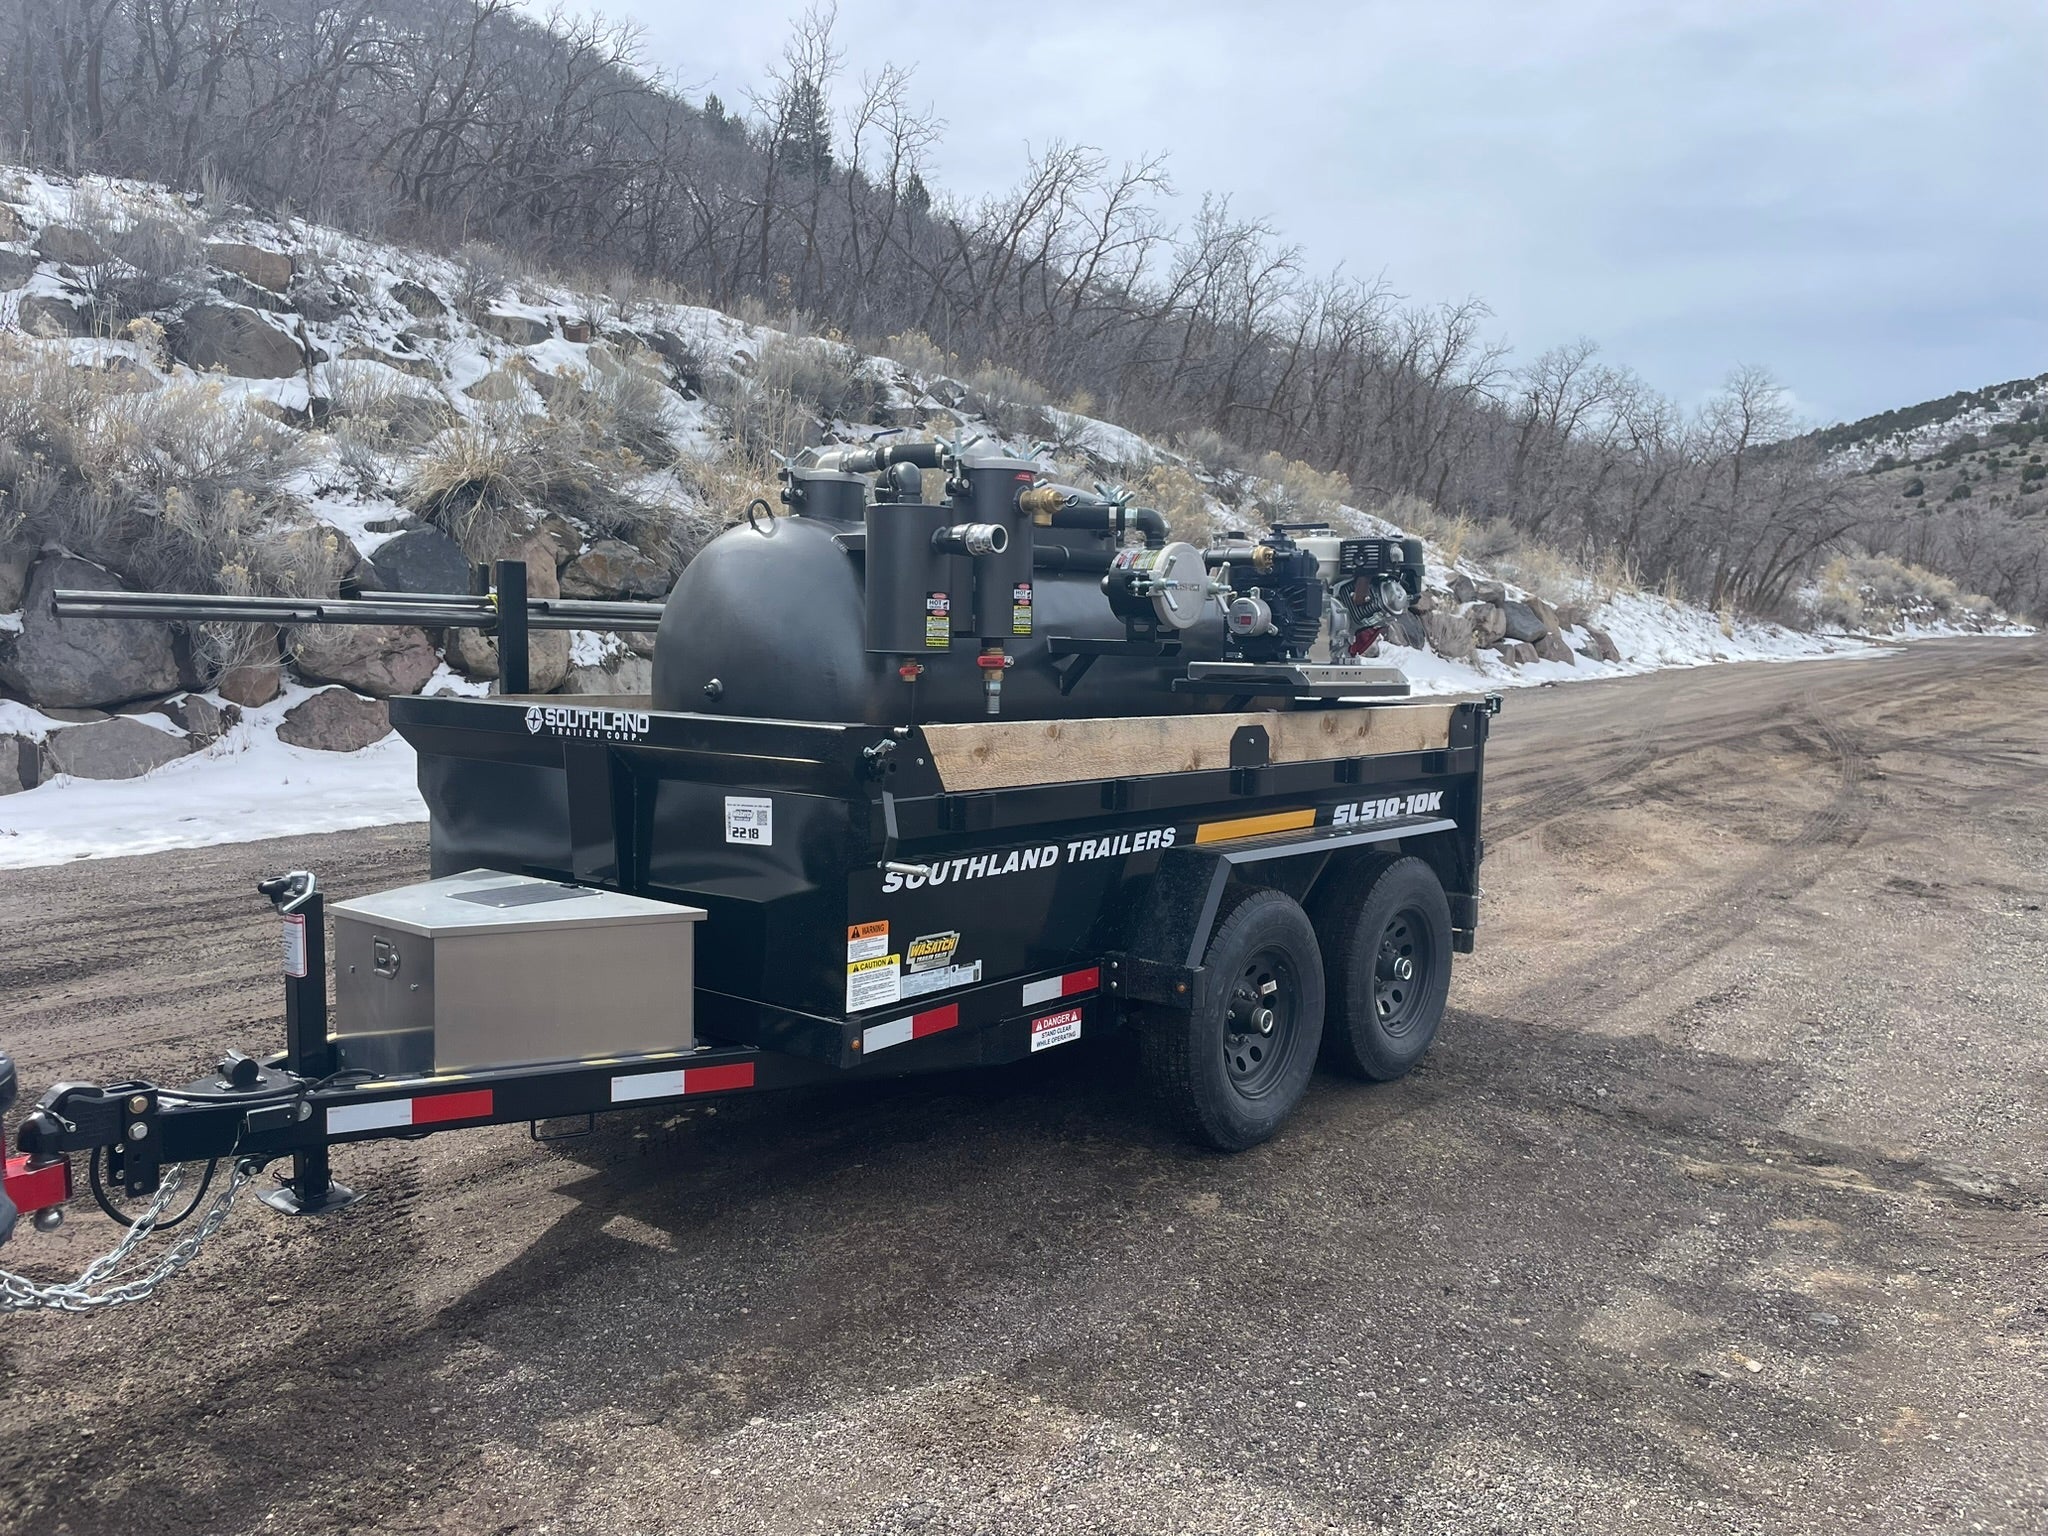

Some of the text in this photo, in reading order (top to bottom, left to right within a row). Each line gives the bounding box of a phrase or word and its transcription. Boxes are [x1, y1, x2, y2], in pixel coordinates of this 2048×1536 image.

[545, 708, 650, 733] SOUTHLAND
[606, 731, 643, 742] CORP.
[1332, 790, 1444, 825] SL510-10K
[732, 827, 759, 839] 2218
[882, 826, 1177, 893] SOUTHLAND TRAILERS
[862, 923, 885, 935] WARNING
[909, 937, 957, 958] WASATCH
[860, 959, 887, 971] CAUTION
[1043, 1013, 1070, 1028] DANGER
[1041, 1025, 1072, 1038] STAND CLEAR
[1036, 1031, 1077, 1048] WHILE OPERATING
